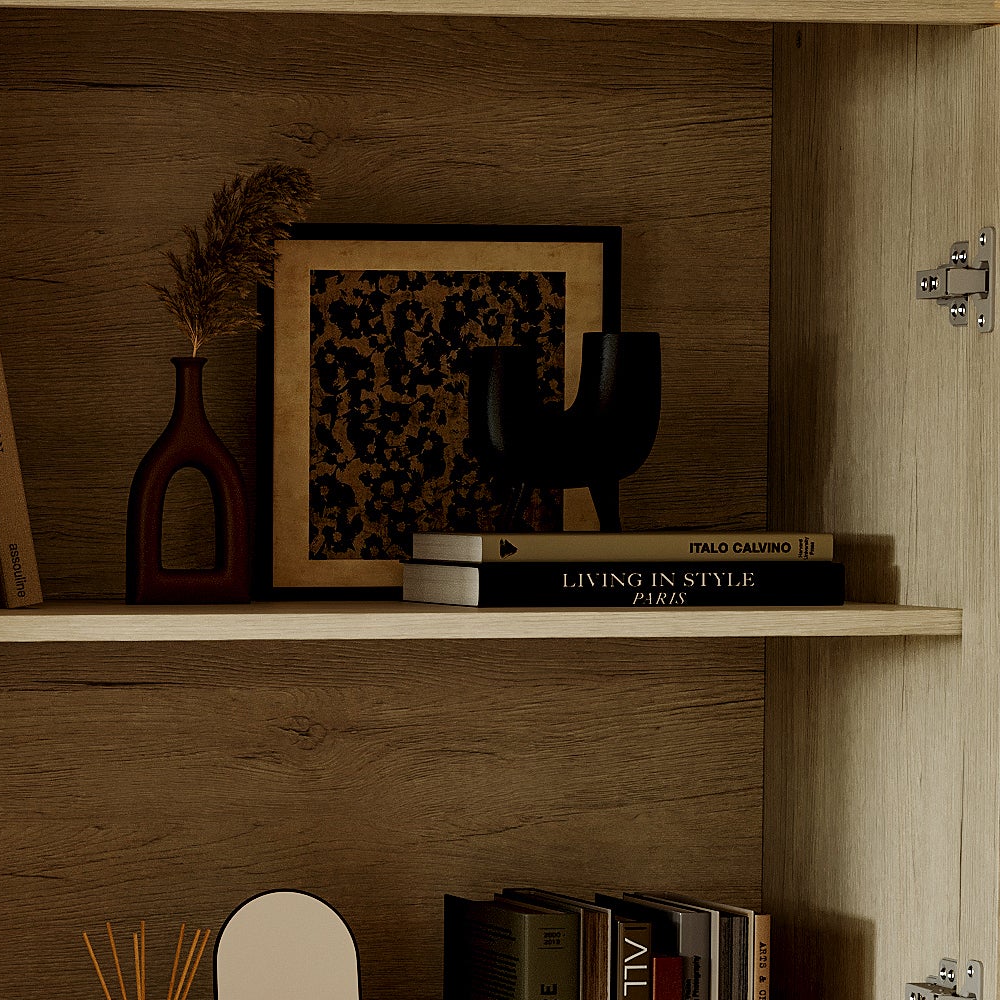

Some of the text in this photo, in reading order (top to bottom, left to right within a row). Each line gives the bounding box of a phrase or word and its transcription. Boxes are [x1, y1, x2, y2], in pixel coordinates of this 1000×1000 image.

[689, 541, 792, 554] ITALO CALVINO
[9, 543, 26, 598] assouline
[563, 572, 755, 588] LIVING IN STYLE
[632, 591, 688, 605] PARIS
[759, 941, 767, 969] ARTS
[623, 937, 648, 996] ALL
